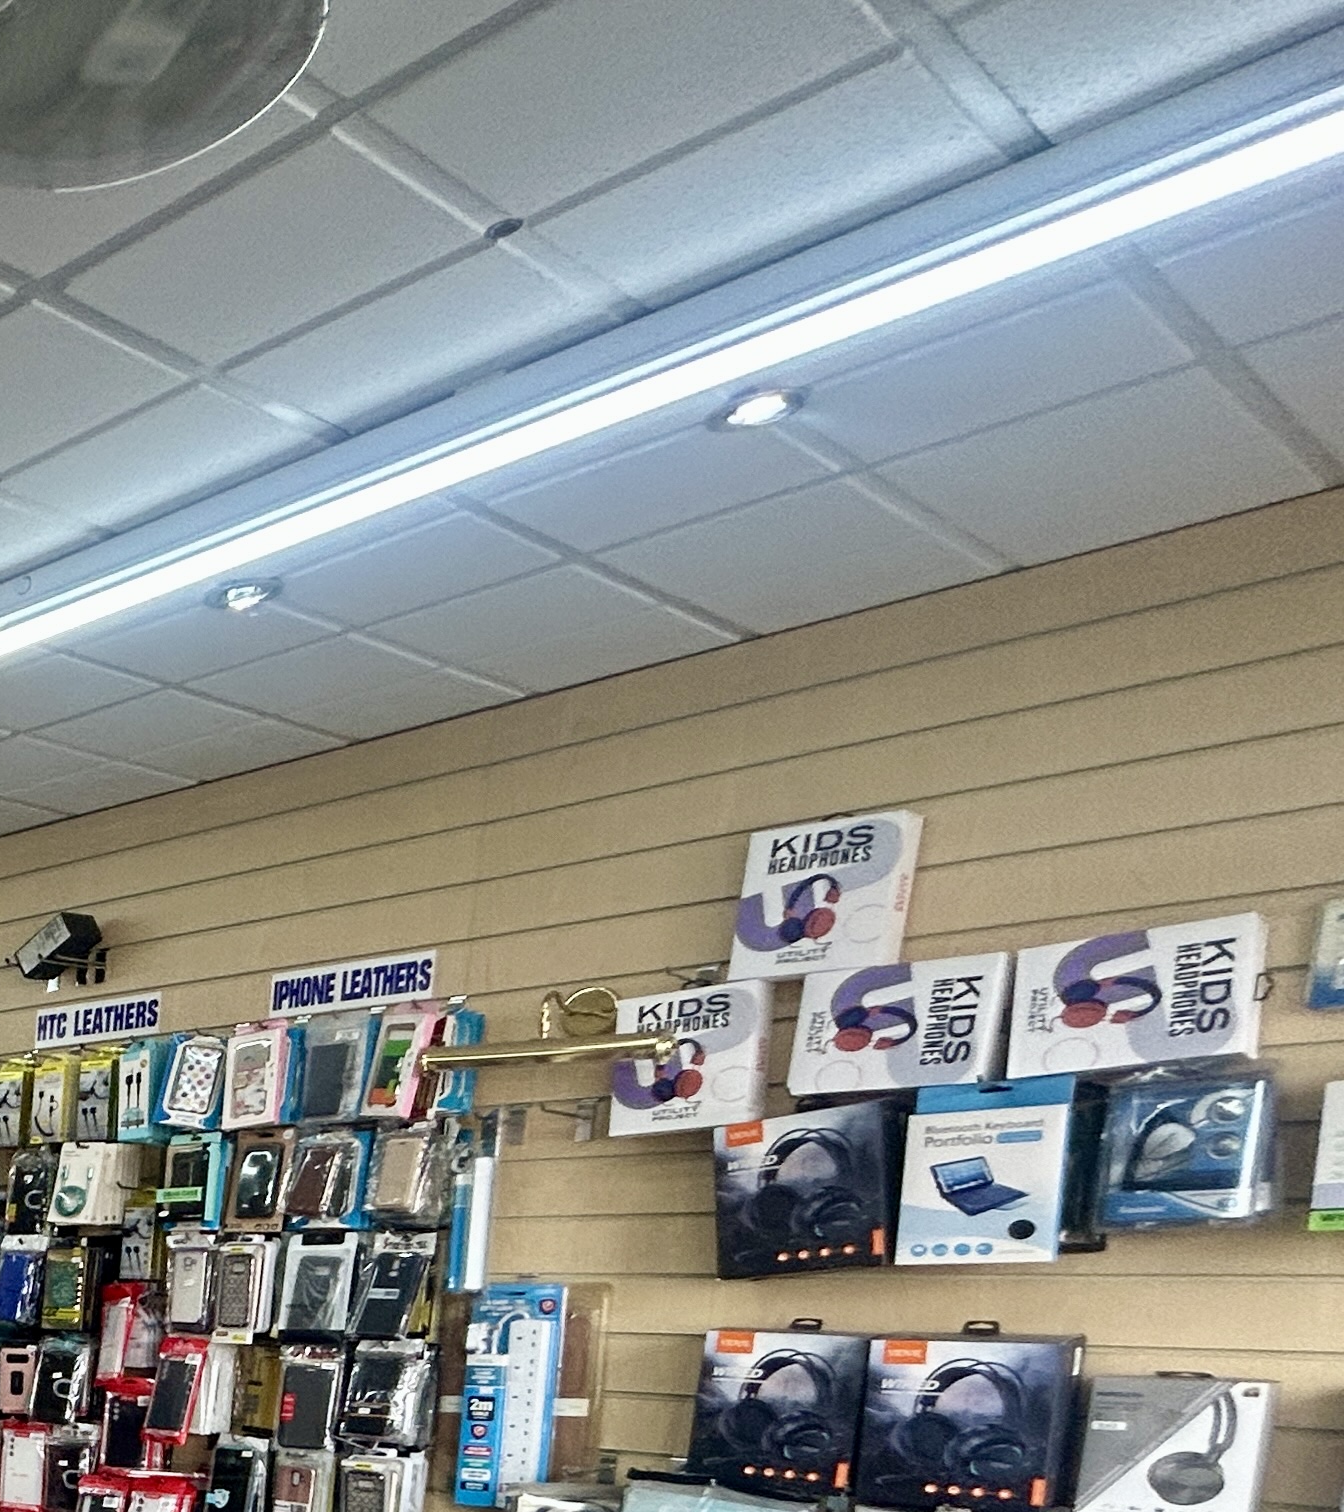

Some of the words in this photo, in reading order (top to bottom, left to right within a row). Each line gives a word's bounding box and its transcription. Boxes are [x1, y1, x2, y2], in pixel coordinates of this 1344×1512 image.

[770, 825, 874, 858] KIDS
[768, 845, 872, 875] HEADPHONES
[273, 973, 336, 1011] IPHONE
[341, 958, 432, 1001] LEATHERS
[1169, 943, 1202, 1037] HEADPHONES
[1198, 937, 1237, 1034] KIDS
[38, 1013, 67, 1041] HTC
[74, 999, 159, 1036] LEATHERS
[638, 993, 731, 1023] KIDS
[920, 978, 954, 1066] HEADPHONES
[944, 975, 983, 1065] KIDS
[925, 1133, 993, 1147] Portfolio
[713, 1366, 763, 1378] WED
[880, 1379, 940, 1391] WED
[469, 1399, 493, 1411] 2m
